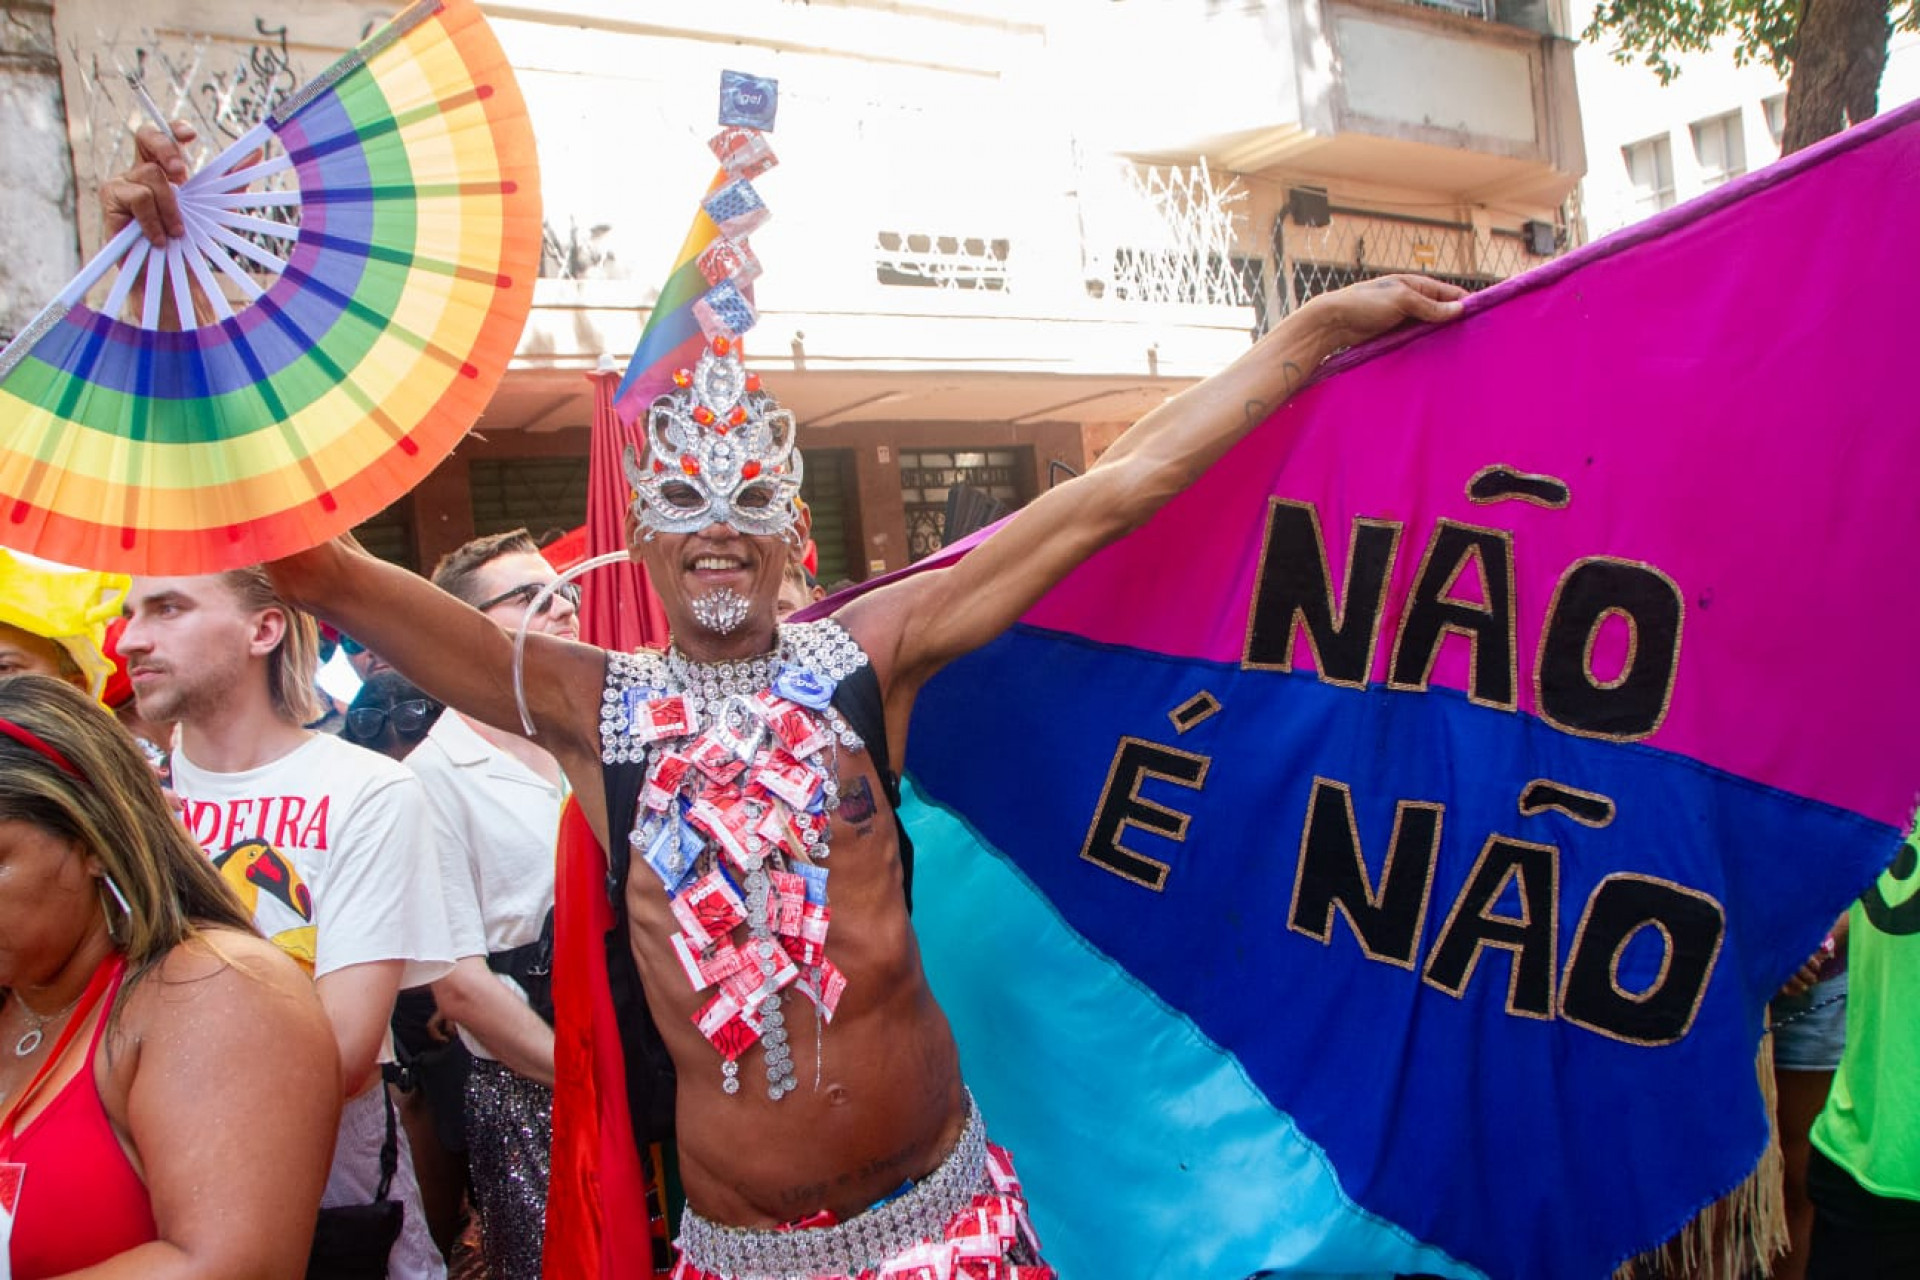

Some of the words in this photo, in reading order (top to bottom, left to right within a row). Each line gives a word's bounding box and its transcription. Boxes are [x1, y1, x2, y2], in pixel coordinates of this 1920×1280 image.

[1241, 464, 1685, 742] NÃO
[1079, 690, 1221, 893] É
[1287, 777, 1726, 1047] NÃO
